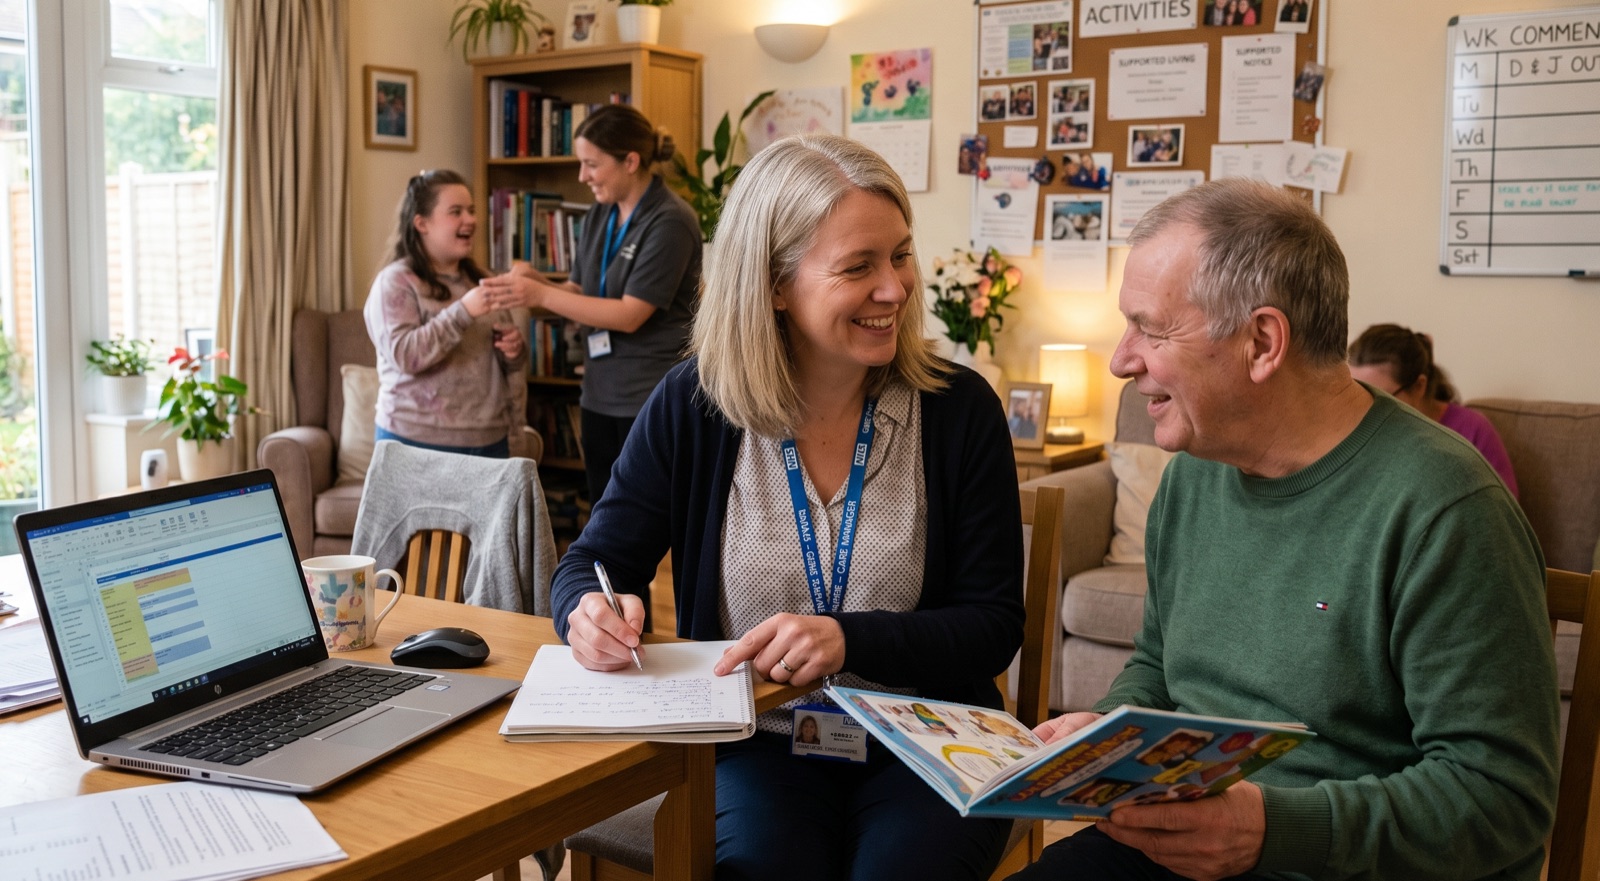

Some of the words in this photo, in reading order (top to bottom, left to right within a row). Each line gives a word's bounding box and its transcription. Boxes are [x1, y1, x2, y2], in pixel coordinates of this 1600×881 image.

[1085, 0, 1191, 25] ACTIVITIES
[1463, 28, 1498, 48] WK
[1510, 21, 1600, 46] COMMEN
[1118, 56, 1166, 67] SUPPORTED
[1167, 54, 1195, 64] LIVING
[1243, 57, 1273, 67] NOTICE
[1460, 62, 1478, 79] M
[1510, 59, 1523, 78] D
[1547, 55, 1563, 75] J
[1457, 95, 1479, 114] Tu
[1456, 127, 1486, 145] Wd
[1455, 158, 1478, 177] Th
[1456, 188, 1470, 208] F
[1455, 220, 1469, 240] S
[786, 448, 797, 469] NHS
[842, 500, 857, 546] MANAGER
[837, 549, 848, 574] CARE
